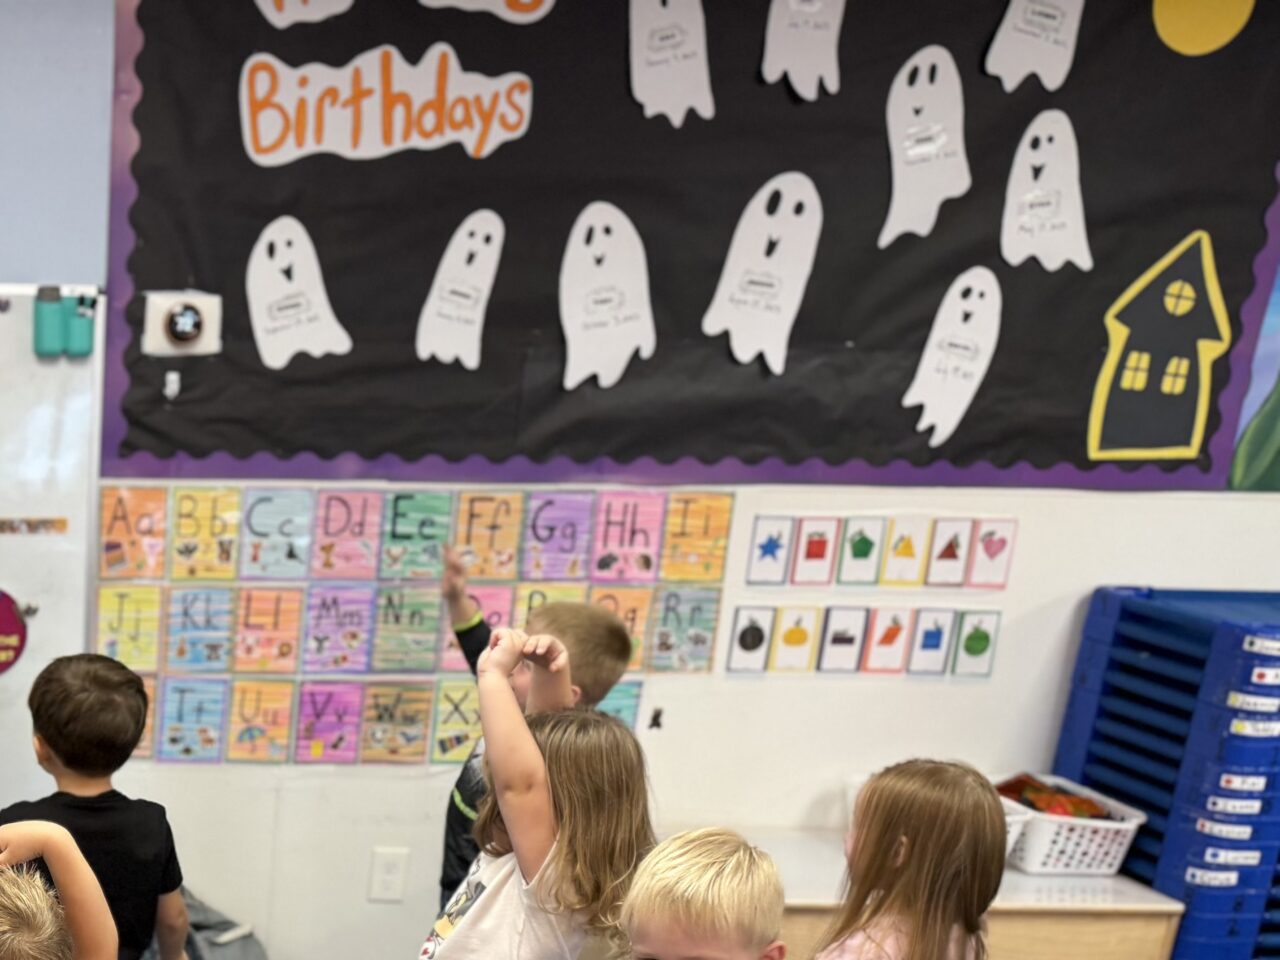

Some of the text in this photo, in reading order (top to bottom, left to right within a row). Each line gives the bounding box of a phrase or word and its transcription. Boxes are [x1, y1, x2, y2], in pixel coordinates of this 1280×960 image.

[247, 50, 530, 159] Birthdays
[107, 497, 158, 536] Aa
[177, 494, 228, 537] Bb
[246, 496, 294, 537] Cc
[325, 495, 367, 537] Dd
[390, 494, 437, 540] Ee
[465, 496, 511, 549] Ff
[531, 499, 577, 553] Gg
[604, 501, 650, 549] Hh
[383, 593, 424, 625] Nn
[663, 592, 703, 627] Rr
[308, 691, 347, 721] Vv
